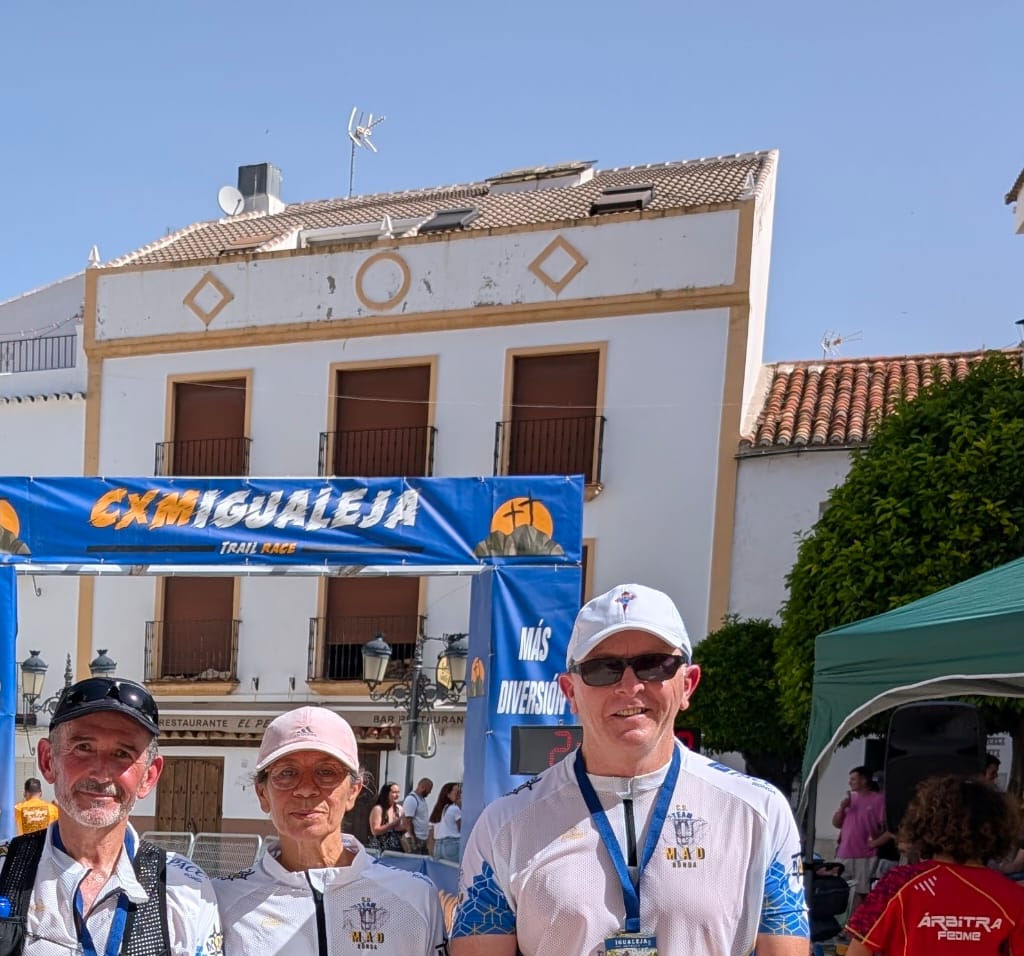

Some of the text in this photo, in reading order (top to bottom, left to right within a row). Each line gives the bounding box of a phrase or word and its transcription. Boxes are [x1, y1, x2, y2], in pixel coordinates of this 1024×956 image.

[220, 541, 296, 554] TRAIL RACE
[518, 619, 552, 662] MÁS
[497, 673, 566, 715] DIVERSIÓN
[159, 719, 273, 728] RESTAURANTE EL PE
[373, 715, 394, 723] BAR
